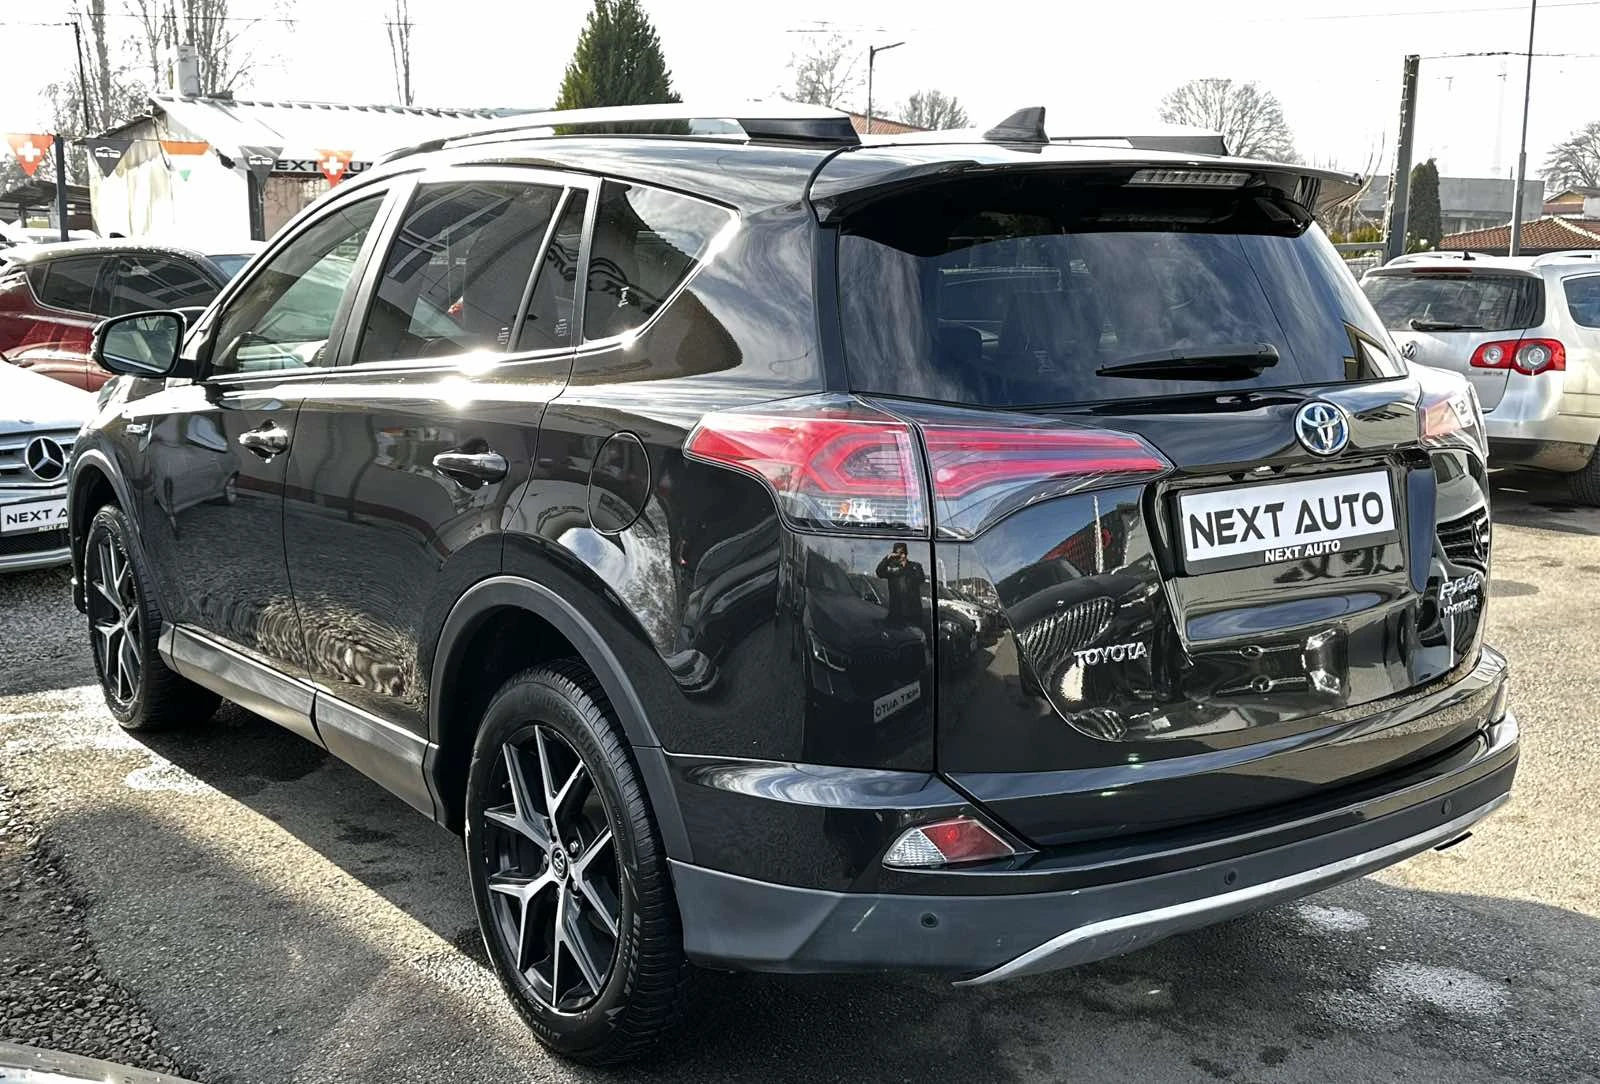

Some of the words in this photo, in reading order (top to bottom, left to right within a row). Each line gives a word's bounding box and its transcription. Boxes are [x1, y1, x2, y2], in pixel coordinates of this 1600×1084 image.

[7, 509, 52, 524] NEXT
[1189, 502, 1284, 549] NEXT
[1295, 491, 1384, 535] AUTO
[1264, 546, 1302, 563] NEXT
[1304, 540, 1341, 557] AUTO
[1072, 642, 1148, 665] TOYOTA
